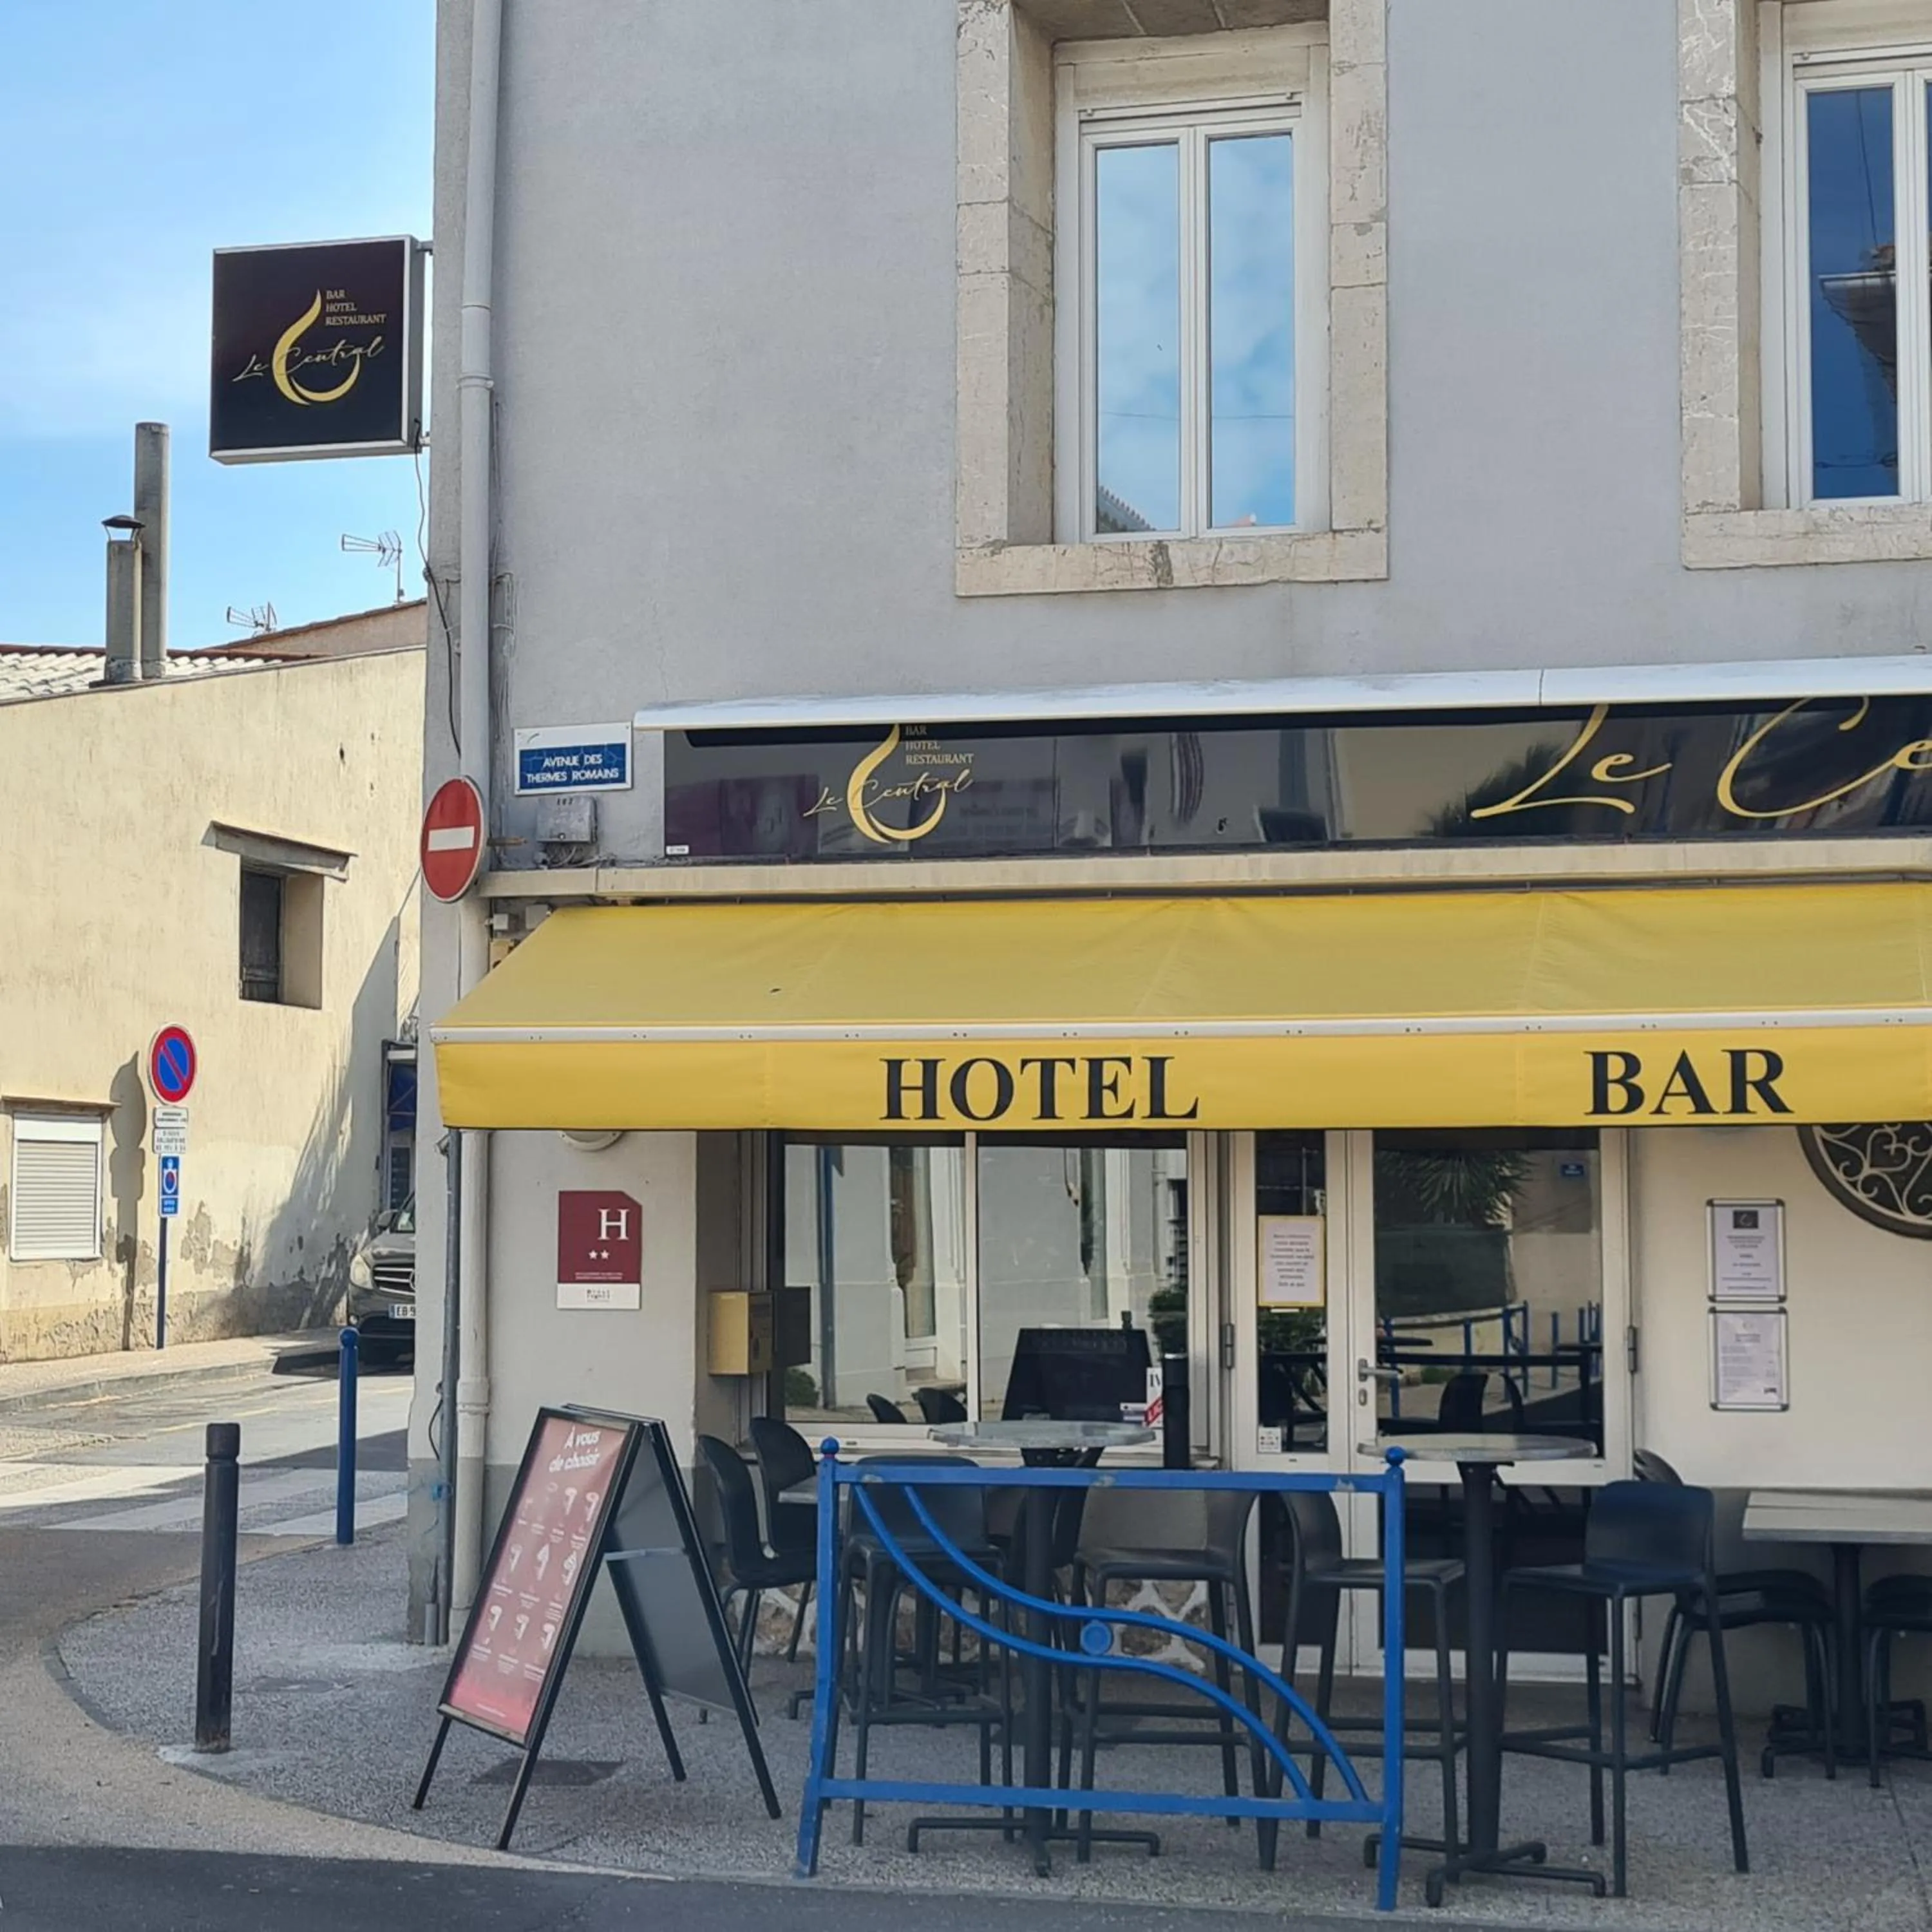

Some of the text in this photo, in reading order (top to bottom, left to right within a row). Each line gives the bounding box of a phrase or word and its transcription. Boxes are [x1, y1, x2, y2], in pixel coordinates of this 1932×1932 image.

[327, 289, 345, 299] BAR
[326, 302, 358, 312] HOTEL
[325, 314, 386, 326] RESTAURANT
[232, 336, 384, 382] Le Central
[905, 724, 927, 735] BAR
[905, 740, 941, 752] HOTEL
[543, 754, 603, 768] AVENUE DES
[905, 753, 974, 765] RESTAURANT
[1470, 702, 1672, 819] Le
[526, 768, 619, 784] THERMES ROMAINS
[803, 769, 974, 817] Le Central
[879, 1056, 1199, 1121] HOTEL
[1583, 1048, 1795, 1115] BAR
[598, 1208, 629, 1240] H
[576, 1430, 601, 1446] vous
[549, 1448, 600, 1473] de choisir
